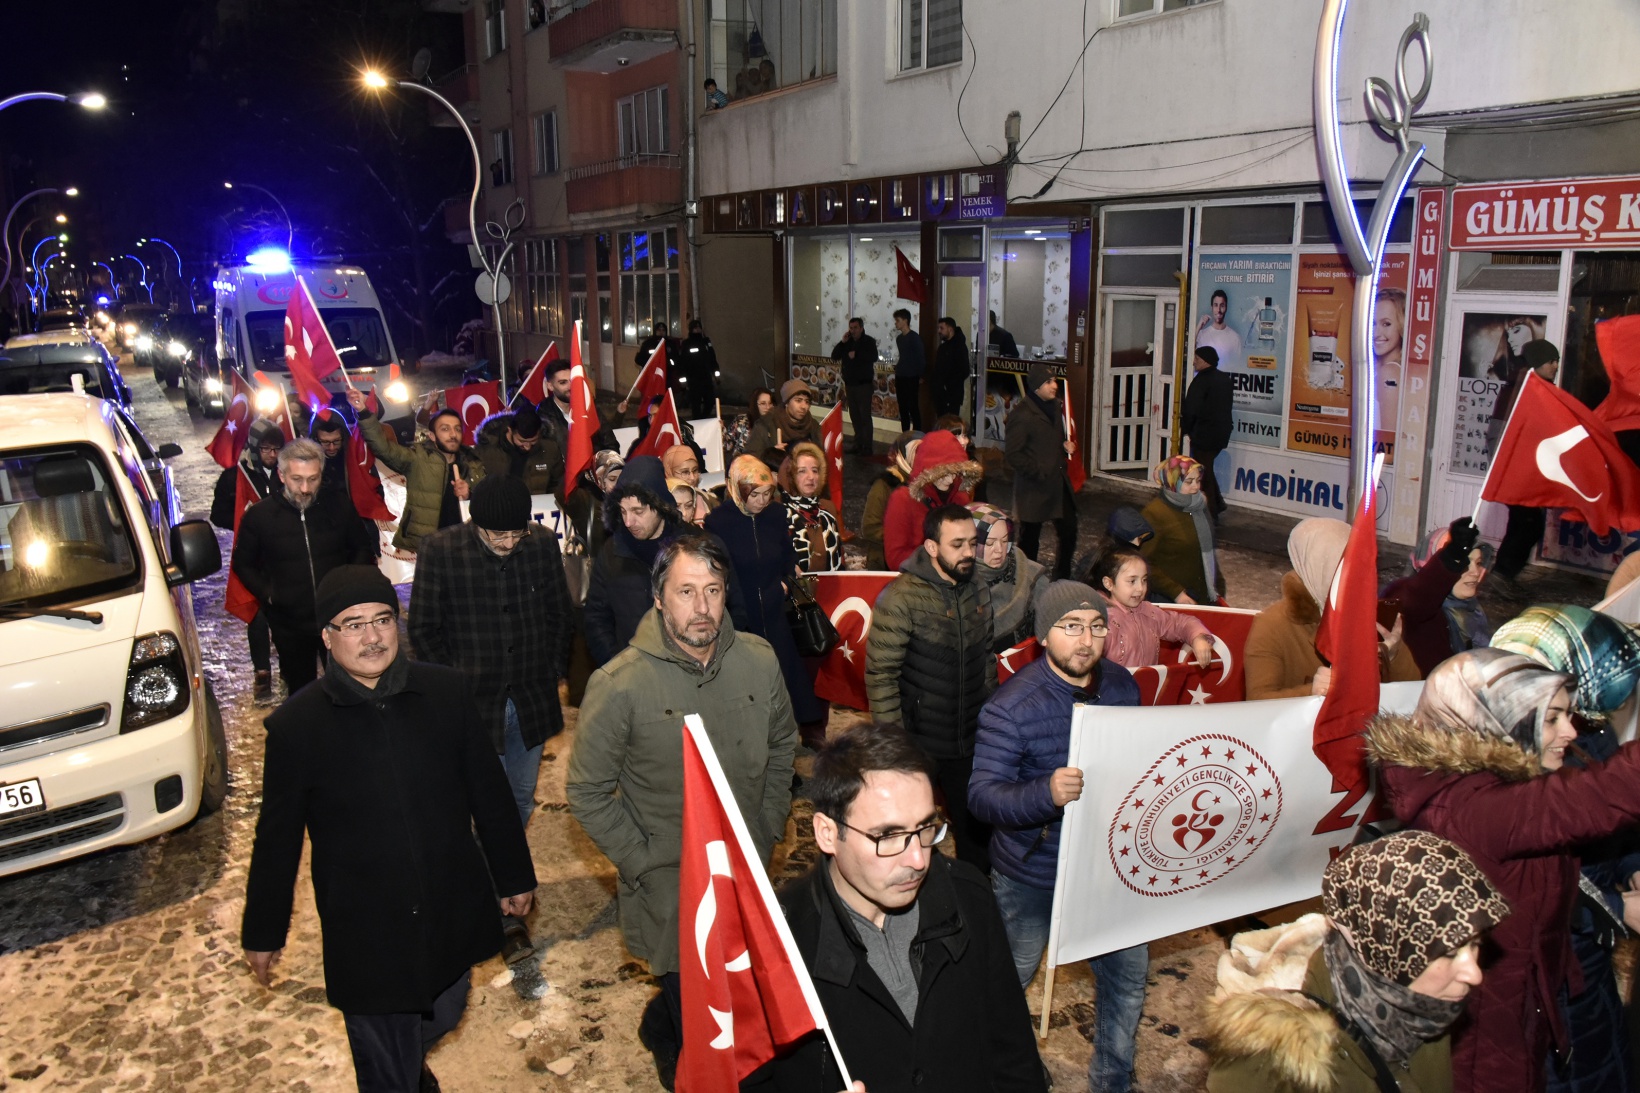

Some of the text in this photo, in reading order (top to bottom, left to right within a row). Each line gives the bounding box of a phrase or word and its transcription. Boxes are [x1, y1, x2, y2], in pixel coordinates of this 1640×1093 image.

[962, 196, 992, 206] YEMEK
[962, 207, 994, 218] SALONU
[1466, 186, 1607, 242] GÜMÜŞ
[1201, 260, 1292, 271] FIRÇANIN YARIM BIRAKTIĞINI
[1214, 271, 1275, 283] LISTERINE BİTİRİR
[1414, 200, 1438, 360] GÜMÜŞ
[989, 359, 1025, 371] ANADOLU
[1237, 418, 1281, 438] İTRİYAT
[1294, 429, 1339, 451] GÜMÜŞ
[1234, 466, 1344, 511] MEDİKAL
[1139, 769, 1253, 868] TÜRKİYE CUMHURİYETİ GENÇLİK VE SPOR BAKANLIĞI
